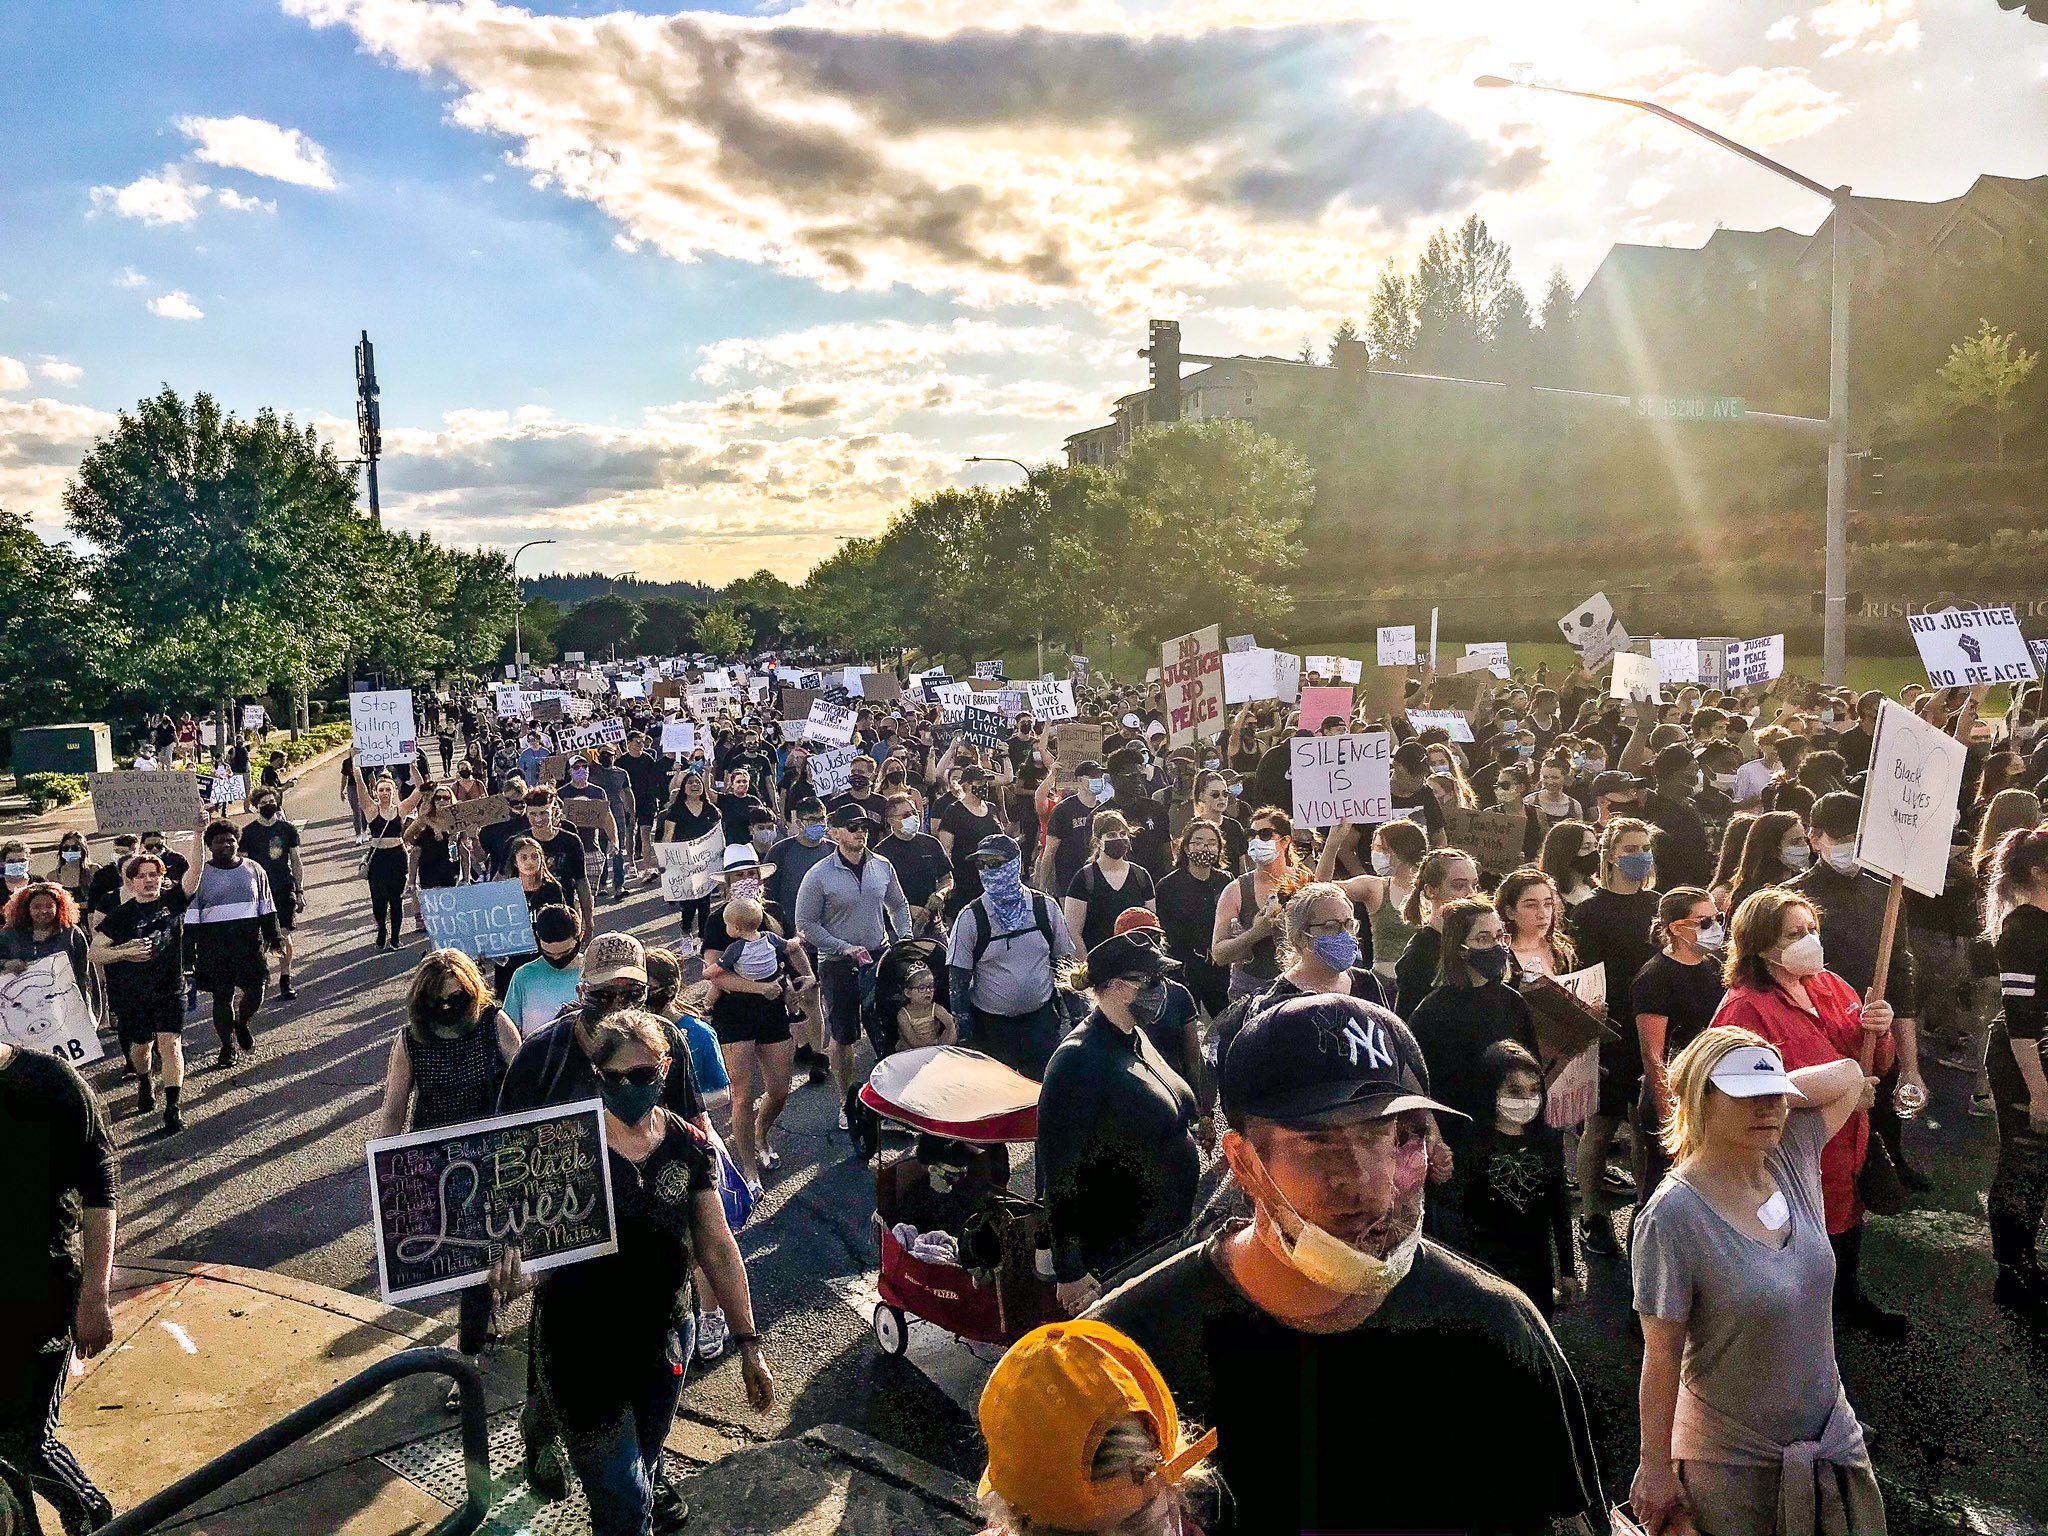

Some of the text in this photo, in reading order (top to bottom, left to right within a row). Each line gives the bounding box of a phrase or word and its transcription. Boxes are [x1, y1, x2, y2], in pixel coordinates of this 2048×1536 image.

[1638, 399, 1738, 418] SE 152ND AVE
[1909, 610, 2015, 633] NO JUSTICE
[1178, 637, 1200, 660] NO
[1727, 643, 1740, 654] NO
[1728, 650, 1767, 668] NO PEACE
[1164, 650, 1220, 688] JUSTICE
[1728, 669, 1740, 680] NO
[1929, 662, 2031, 687] NO PEACE
[944, 693, 951, 704] I
[1031, 682, 1063, 697] BLACK
[1181, 680, 1203, 703] NO
[359, 695, 398, 715] Stop
[701, 707, 719, 715] MATTER
[1037, 695, 1059, 708] LIVES
[968, 708, 1006, 728] BLACK
[1035, 704, 1069, 719] MATTER
[1171, 697, 1218, 733] PEACE
[354, 716, 400, 737] killing
[602, 719, 618, 727] USA
[972, 721, 998, 735] LIVES
[360, 734, 394, 751] black
[558, 730, 576, 739] END
[560, 731, 605, 752] RACISM
[605, 731, 621, 742] SIN
[359, 748, 401, 766] people
[1296, 738, 1387, 767] SILENCE
[807, 758, 823, 775] No
[1894, 758, 1922, 784] Black
[92, 772, 190, 784] WE SHOULD BE
[813, 776, 831, 794] No
[1328, 768, 1353, 794] IS
[163, 786, 190, 794] THAT
[1902, 785, 1931, 809] LIVES
[96, 800, 132, 810] BLACK
[108, 808, 139, 818] WANT
[1298, 797, 1387, 824] VIOLENCE
[101, 821, 124, 830] AND
[128, 820, 150, 828] NOT
[1891, 808, 1919, 829] MATTER
[424, 892, 455, 913] NO
[427, 904, 523, 935] JUSTICE
[1343, 1016, 1393, 1069] NY
[481, 1139, 597, 1191] Black
[397, 1160, 597, 1265] Lives
[533, 1224, 602, 1251] Matter
